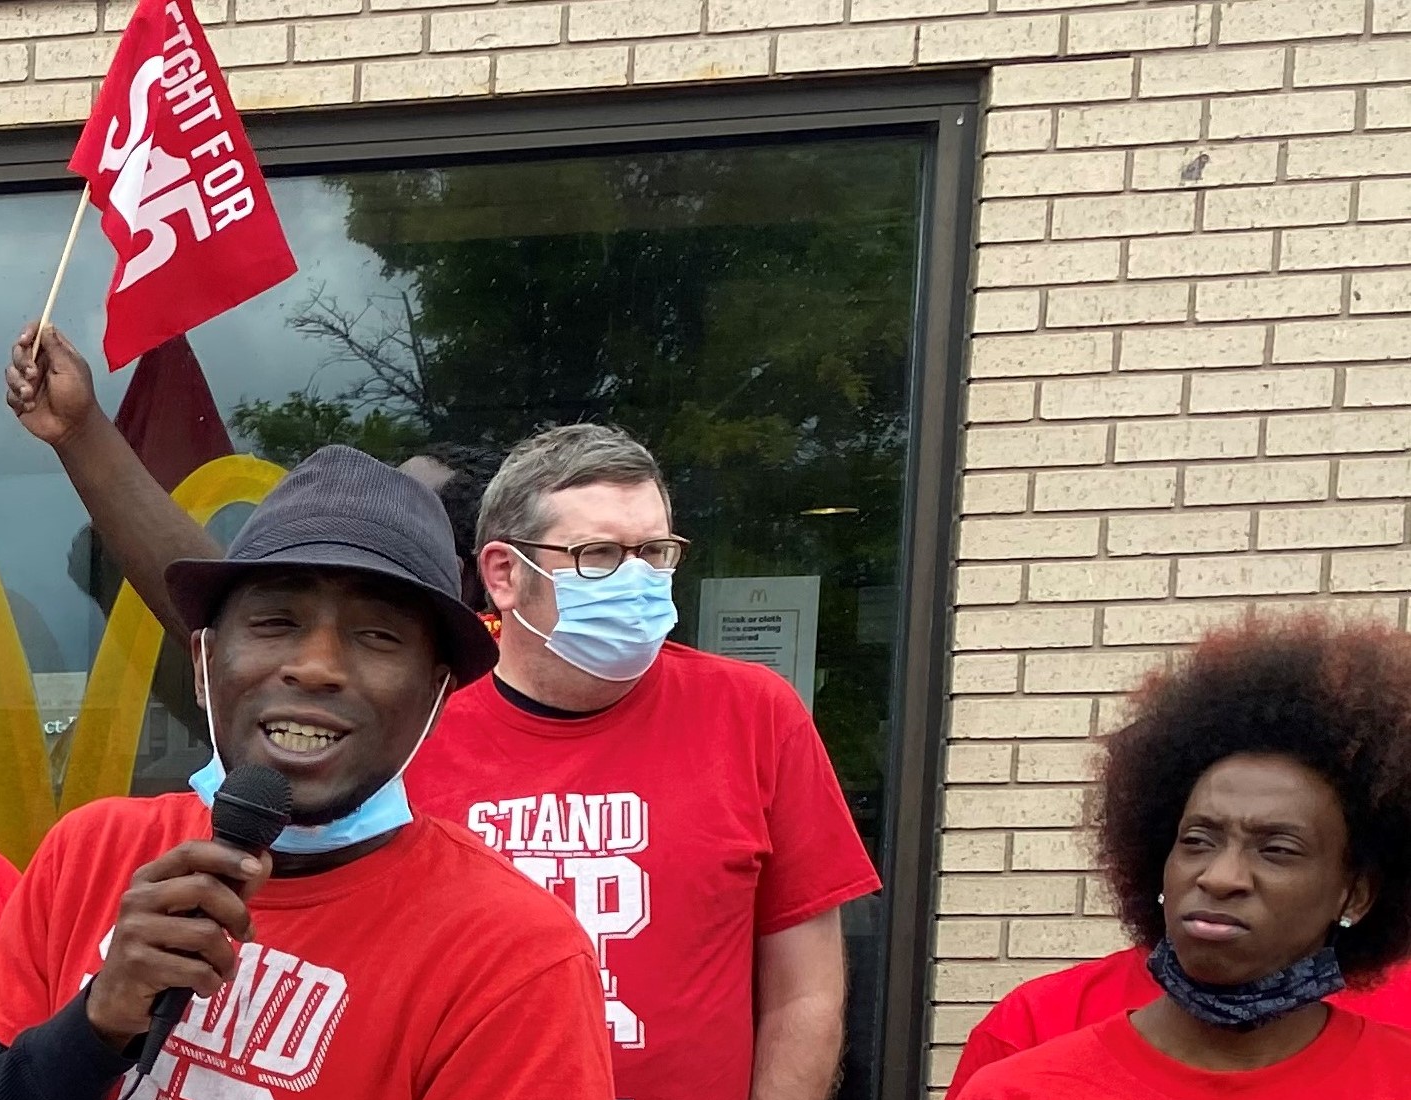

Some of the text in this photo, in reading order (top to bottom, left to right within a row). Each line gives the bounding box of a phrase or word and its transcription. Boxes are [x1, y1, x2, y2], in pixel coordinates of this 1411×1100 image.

[190, 130, 255, 232] FOR
[468, 792, 648, 853] STAND
[513, 856, 650, 968] P
